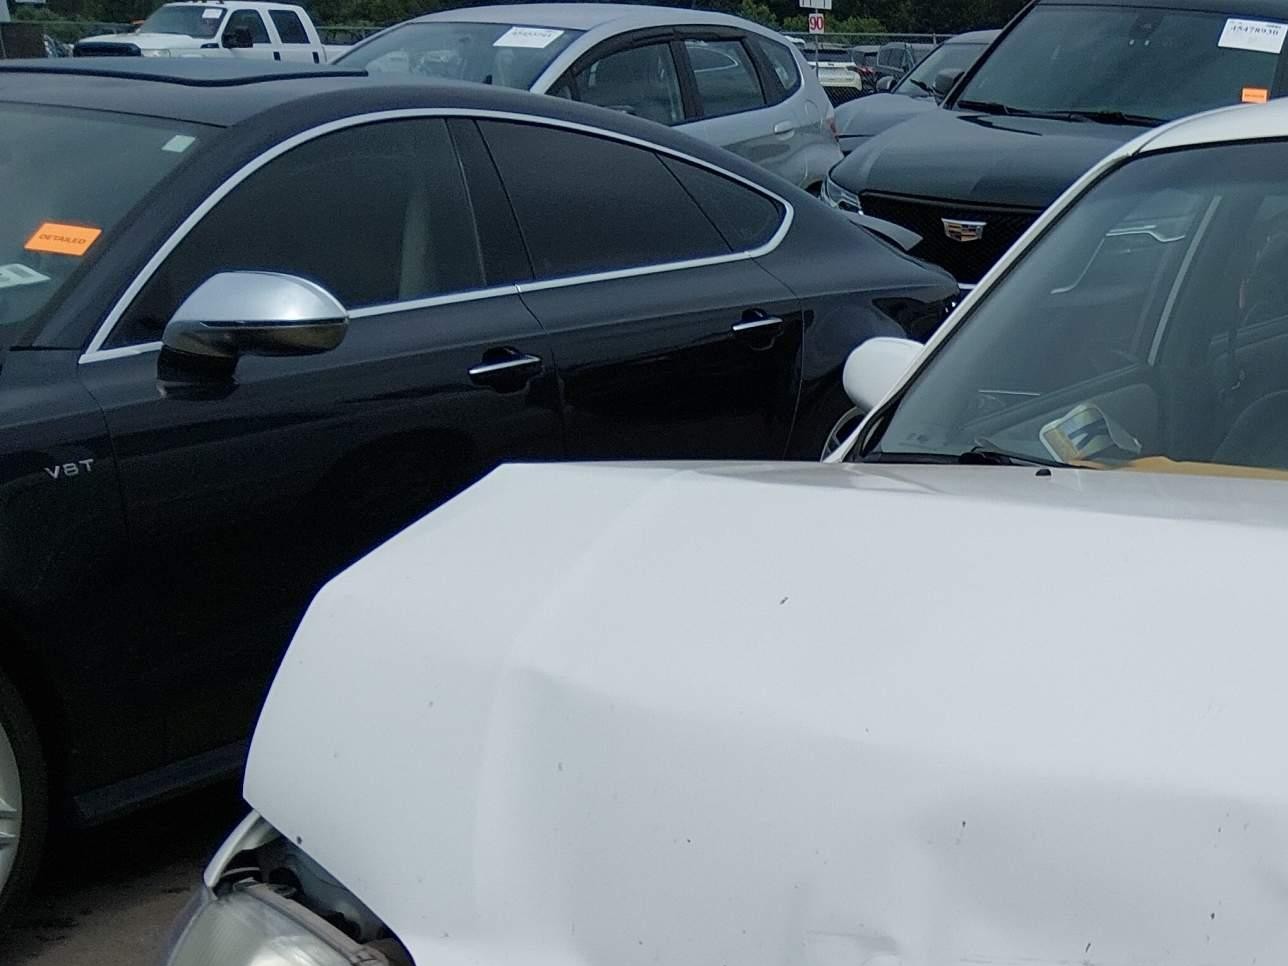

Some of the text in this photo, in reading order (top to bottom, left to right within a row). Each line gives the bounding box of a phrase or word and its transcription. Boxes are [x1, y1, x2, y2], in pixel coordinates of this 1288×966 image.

[809, 16, 824, 31] 90
[38, 233, 87, 246] DETAILED
[43, 458, 95, 479] V8T
